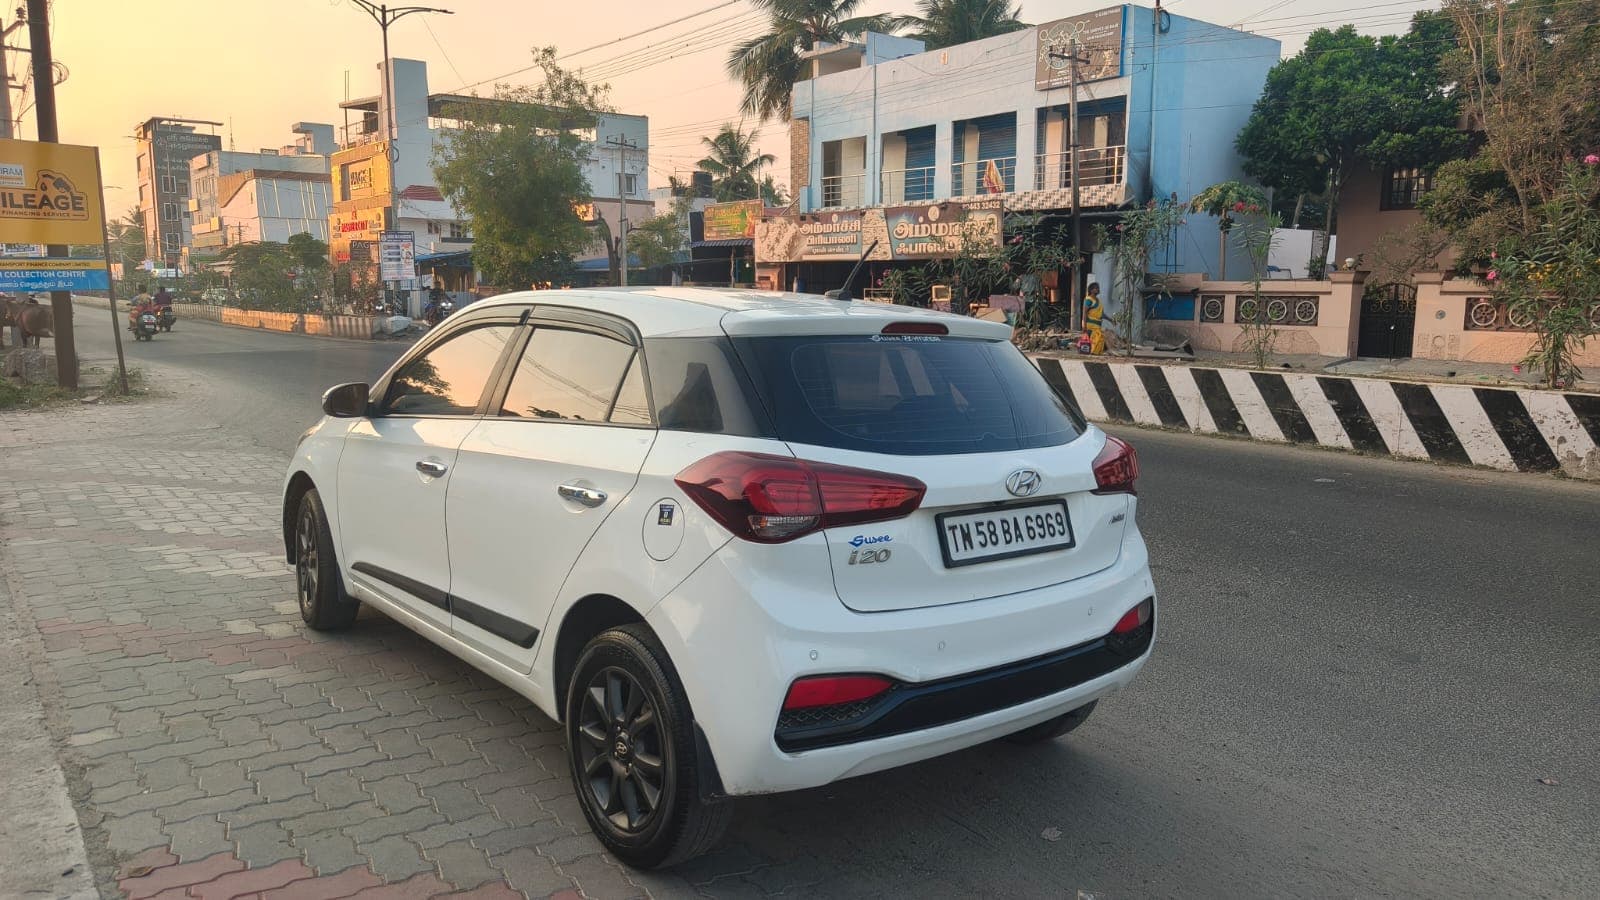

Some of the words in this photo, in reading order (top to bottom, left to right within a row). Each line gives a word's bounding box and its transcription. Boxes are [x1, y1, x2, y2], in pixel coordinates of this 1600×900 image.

[5, 270, 55, 278] COLLECTION
[57, 270, 87, 278] CENTRE
[947, 522, 974, 553] TN
[975, 520, 999, 548] 58
[1001, 516, 1024, 545] BA
[1025, 511, 1066, 540] 6969
[848, 534, 893, 548] Susee
[848, 549, 892, 566] i20
